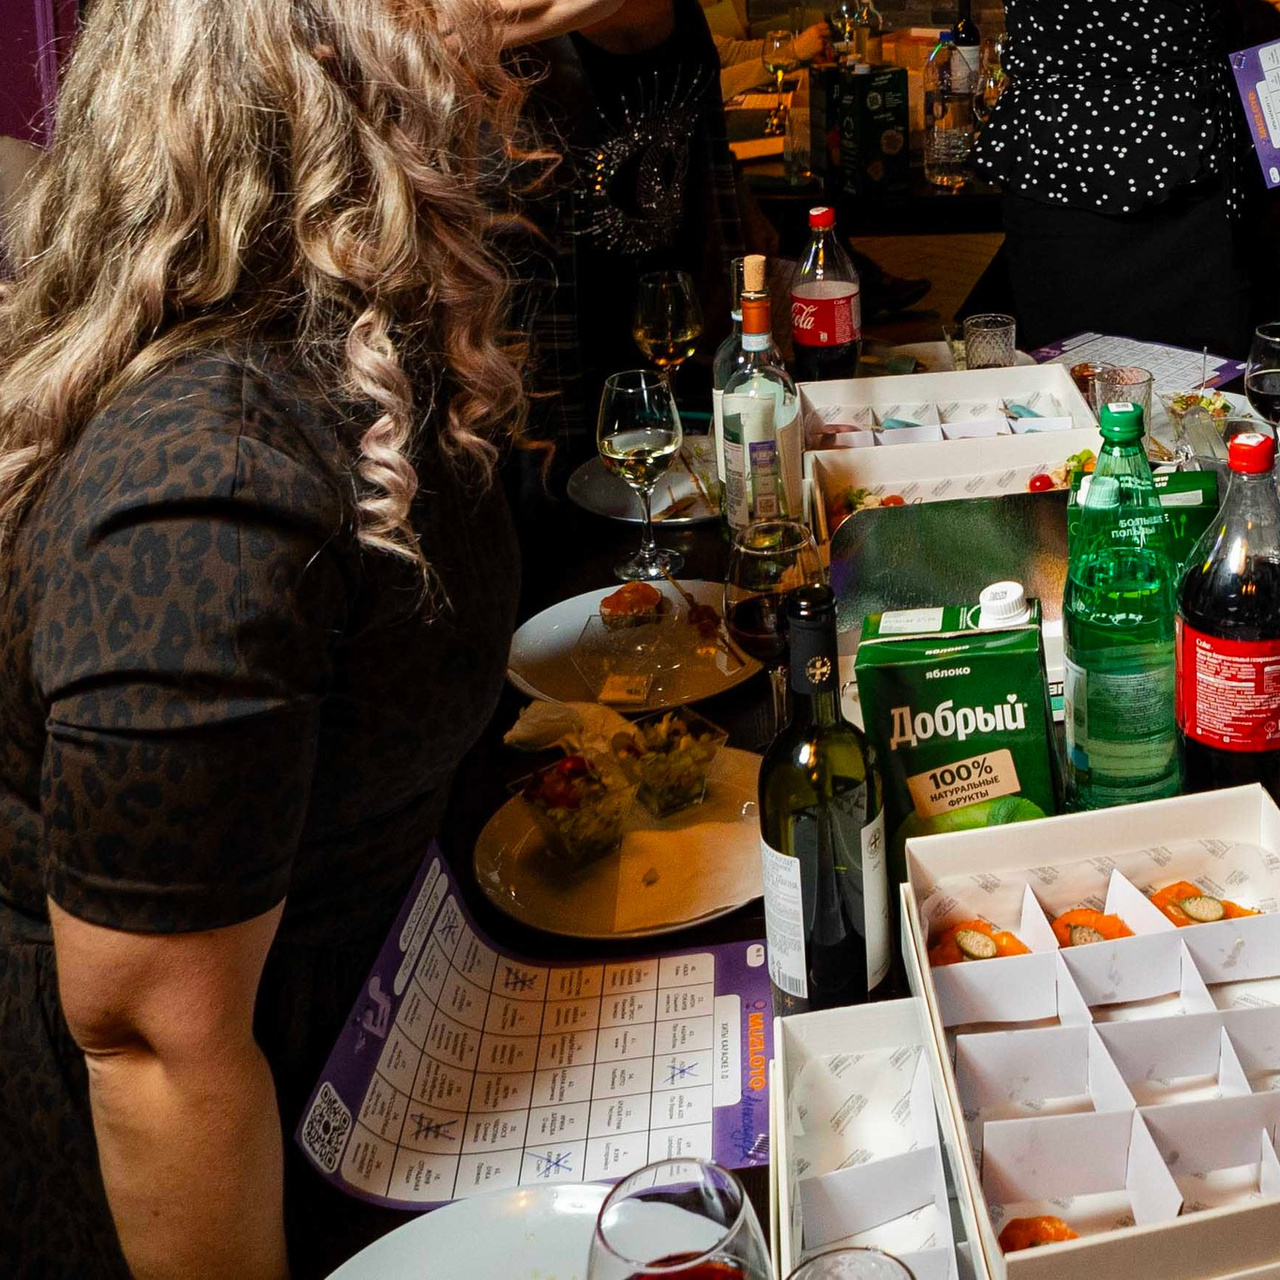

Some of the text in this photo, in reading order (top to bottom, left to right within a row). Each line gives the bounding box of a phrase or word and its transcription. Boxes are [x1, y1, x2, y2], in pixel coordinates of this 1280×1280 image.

[925, 667, 970, 680] яблоко
[890, 694, 1026, 751] Добрый
[928, 757, 993, 790] 100%
[930, 775, 1000, 803] НАТУРАЛЬНЫЕ
[948, 789, 989, 807] ФРУКТЫ
[720, 1039, 729, 1069] КАРАОКЕ
[748, 1012, 766, 1090] MUZLOTO
